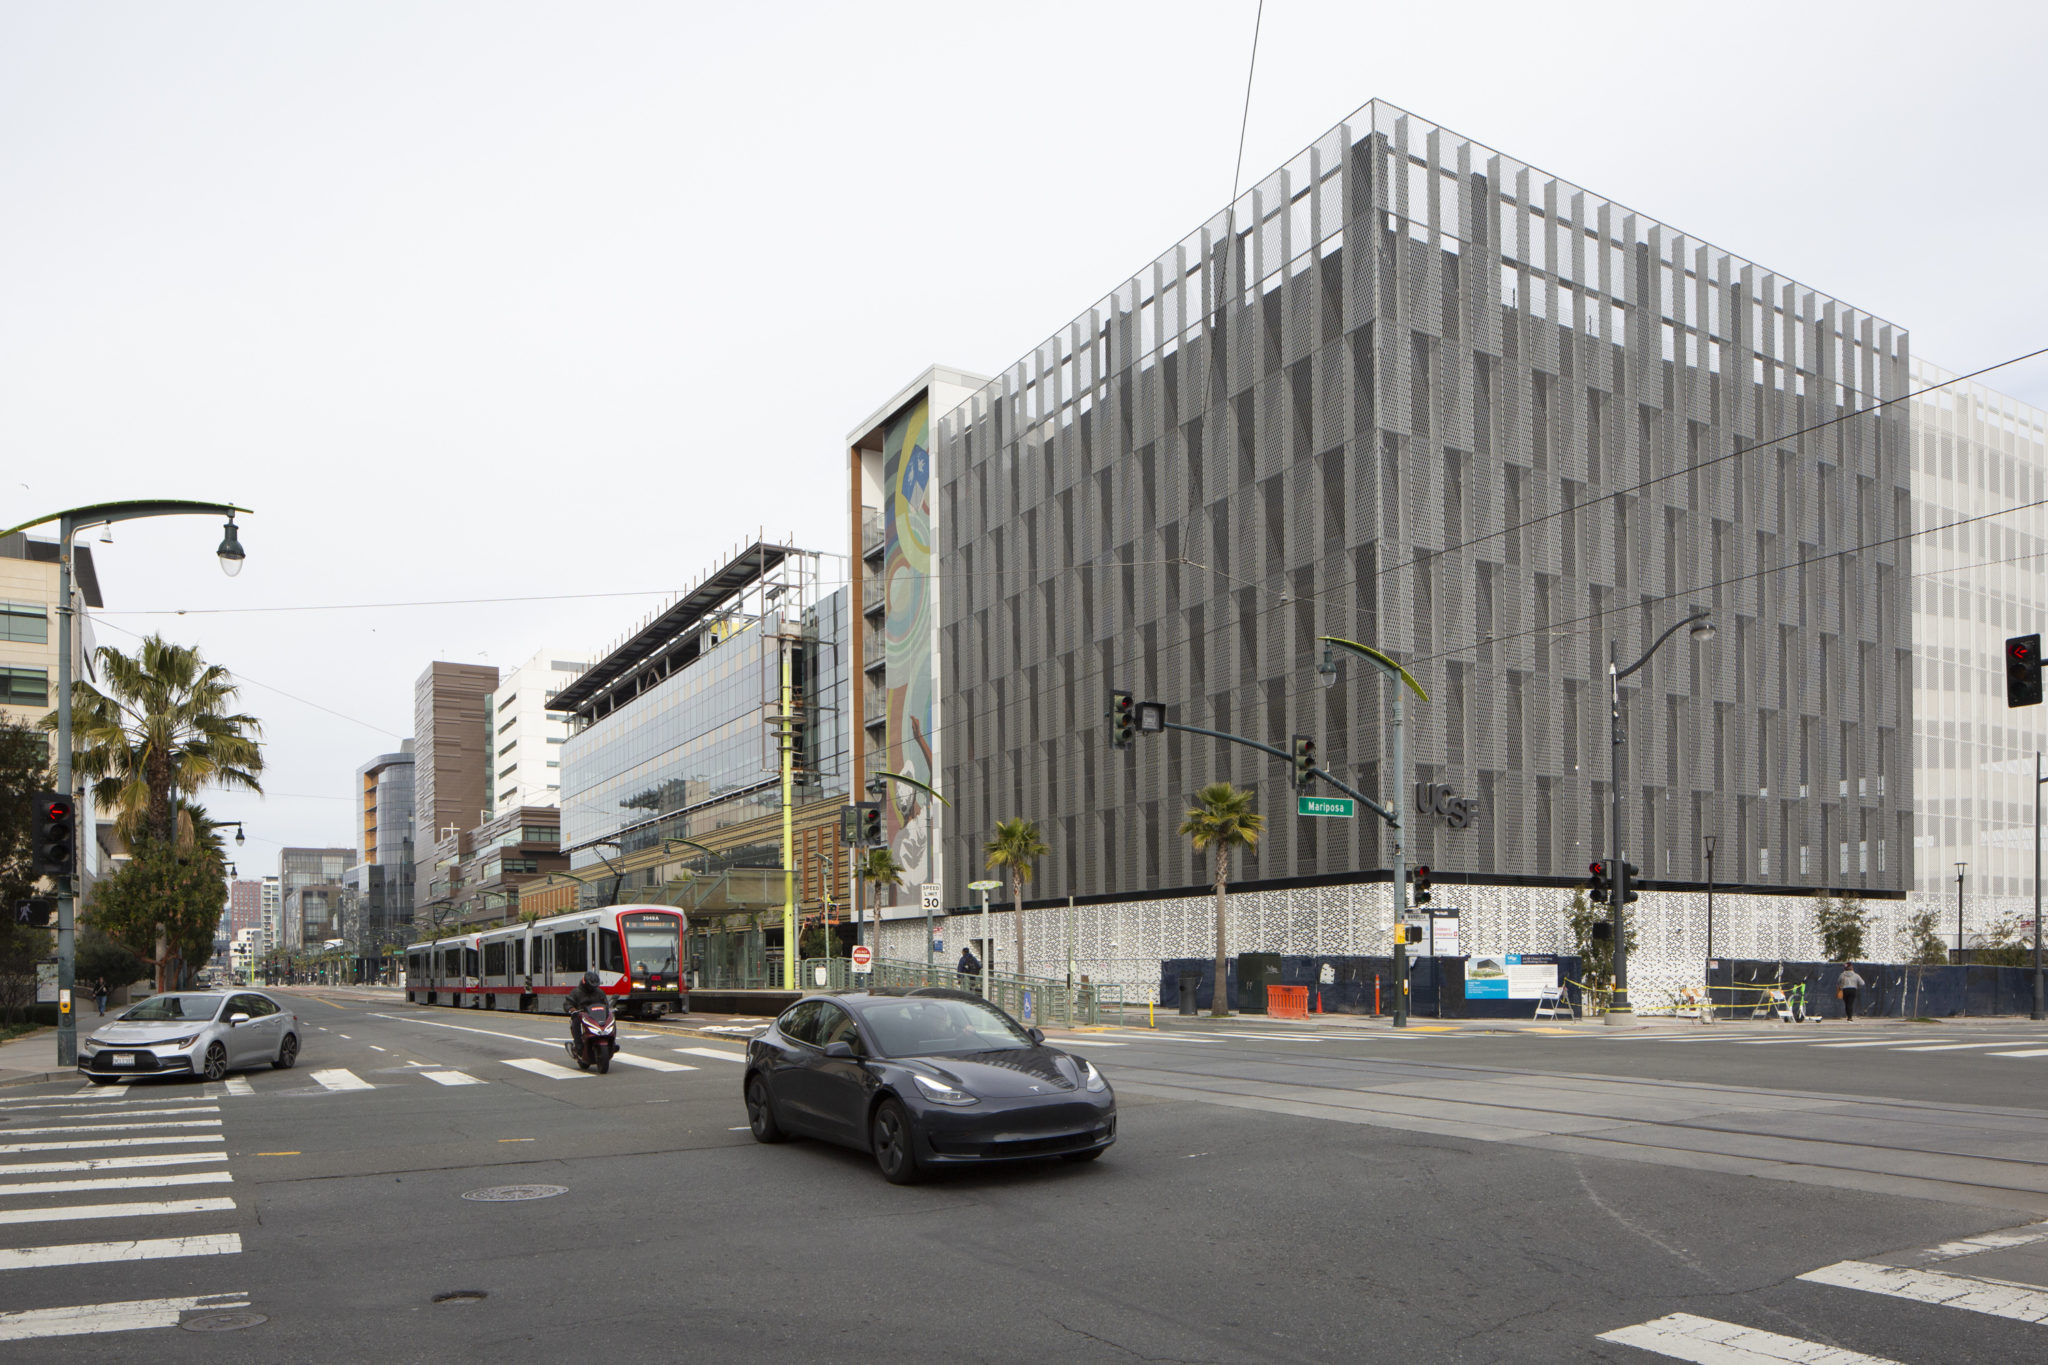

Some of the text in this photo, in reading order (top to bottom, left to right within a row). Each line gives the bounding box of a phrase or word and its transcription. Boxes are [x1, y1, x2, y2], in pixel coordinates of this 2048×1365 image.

[1308, 801, 1345, 814] Mariposa
[1415, 782, 1480, 829] UCSF
[923, 897, 939, 908] 30
